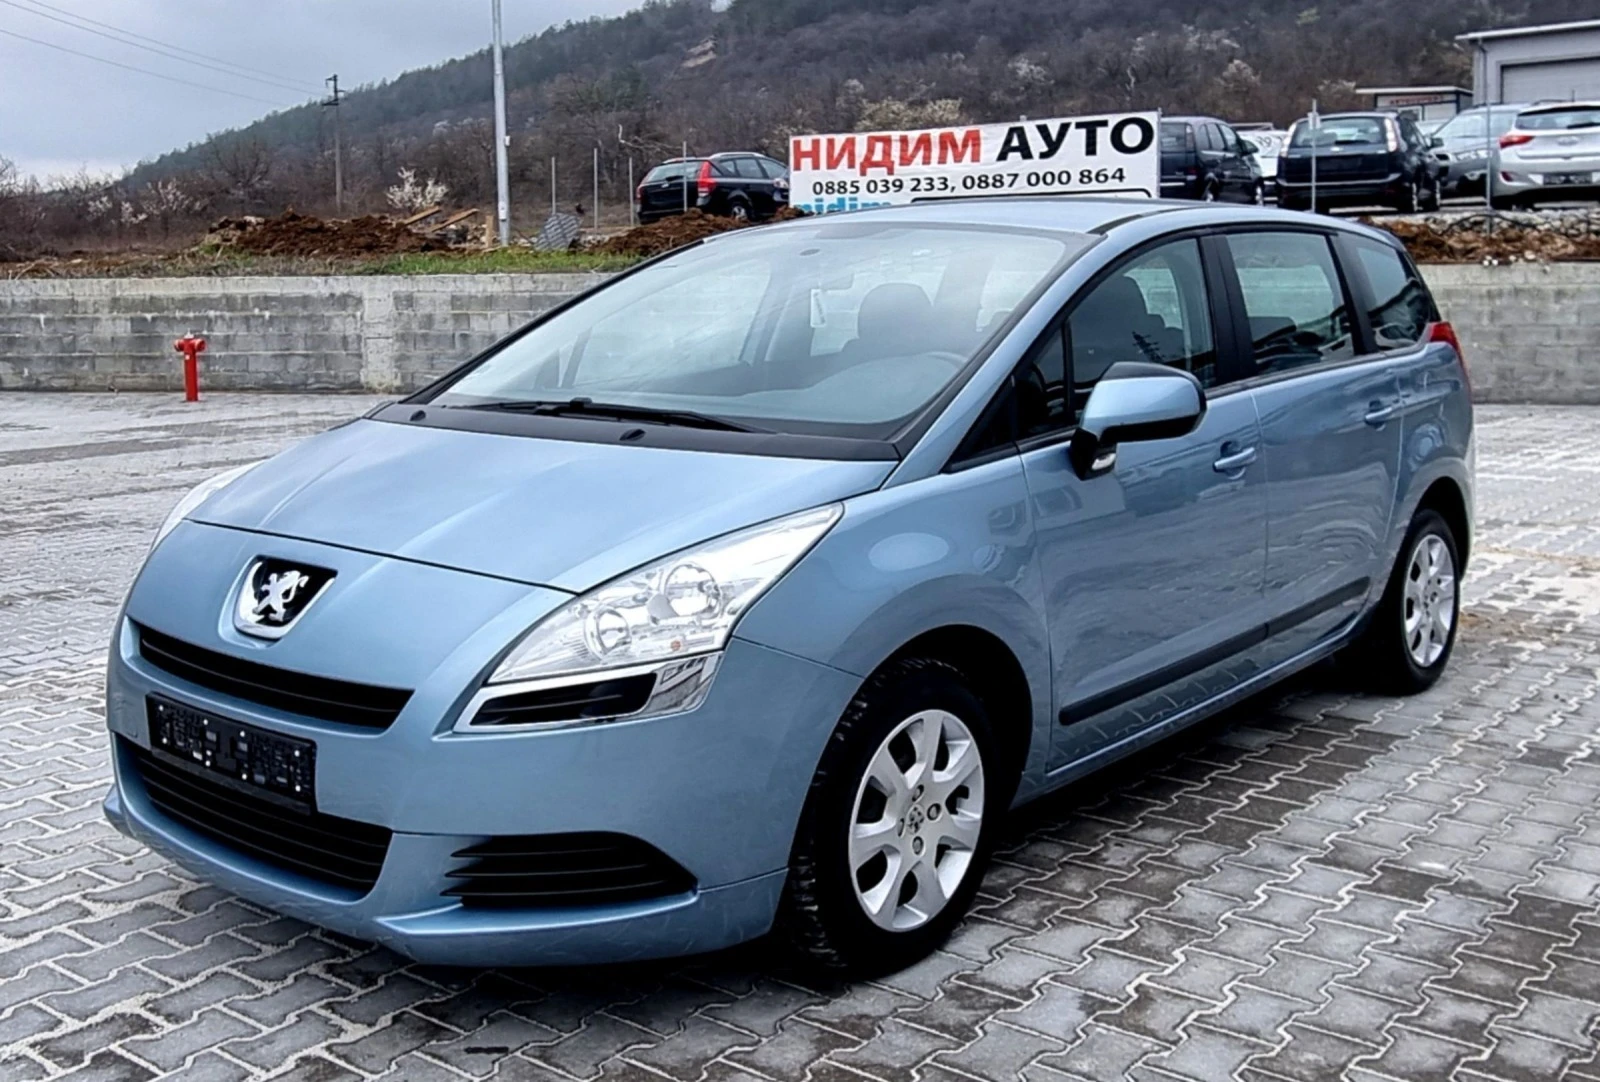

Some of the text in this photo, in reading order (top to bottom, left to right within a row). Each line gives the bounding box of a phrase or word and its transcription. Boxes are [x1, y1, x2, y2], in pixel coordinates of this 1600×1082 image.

[792, 116, 1155, 176] НИДИМ АУТО
[812, 167, 1126, 196] 0885 039 233, 0887 000 864
